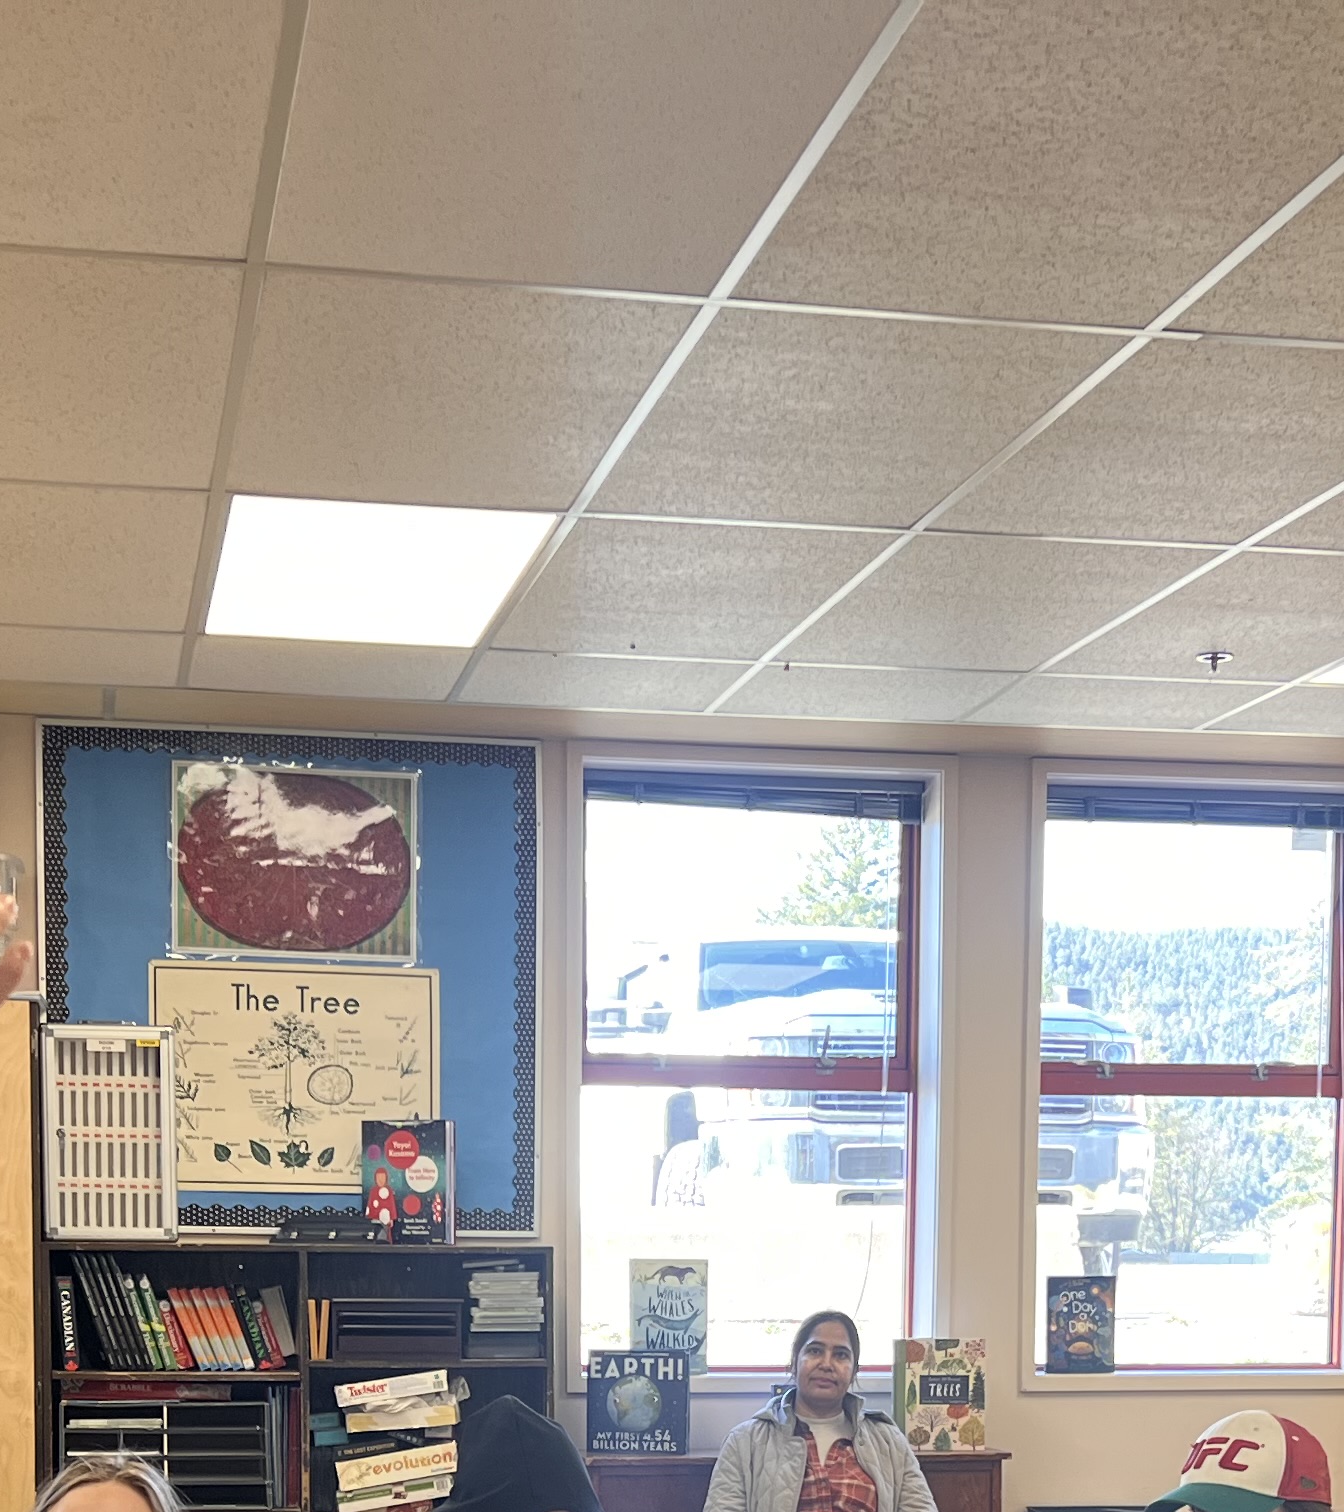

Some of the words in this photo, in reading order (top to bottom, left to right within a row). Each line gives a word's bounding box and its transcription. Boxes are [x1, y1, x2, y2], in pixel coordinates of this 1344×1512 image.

[231, 982, 280, 1012] The
[295, 985, 361, 1015] Tree
[392, 1141, 412, 1150] Yayoi
[1060, 1289, 1086, 1304] One
[648, 1297, 695, 1318] WHALES
[1072, 1300, 1097, 1316] Day
[60, 1290, 76, 1352] CANADIAN
[1078, 1312, 1087, 1321] a
[646, 1327, 695, 1350] WALKED
[590, 1357, 684, 1381] EARTH!
[347, 1383, 388, 1398] Twister
[929, 1383, 961, 1397] TREES
[596, 1432, 613, 1440] MY
[615, 1431, 640, 1440] FIRST
[642, 1429, 671, 1442] 4.54
[592, 1440, 639, 1450] BILLION
[642, 1441, 677, 1452] YEARS
[372, 1450, 453, 1475] evolution
